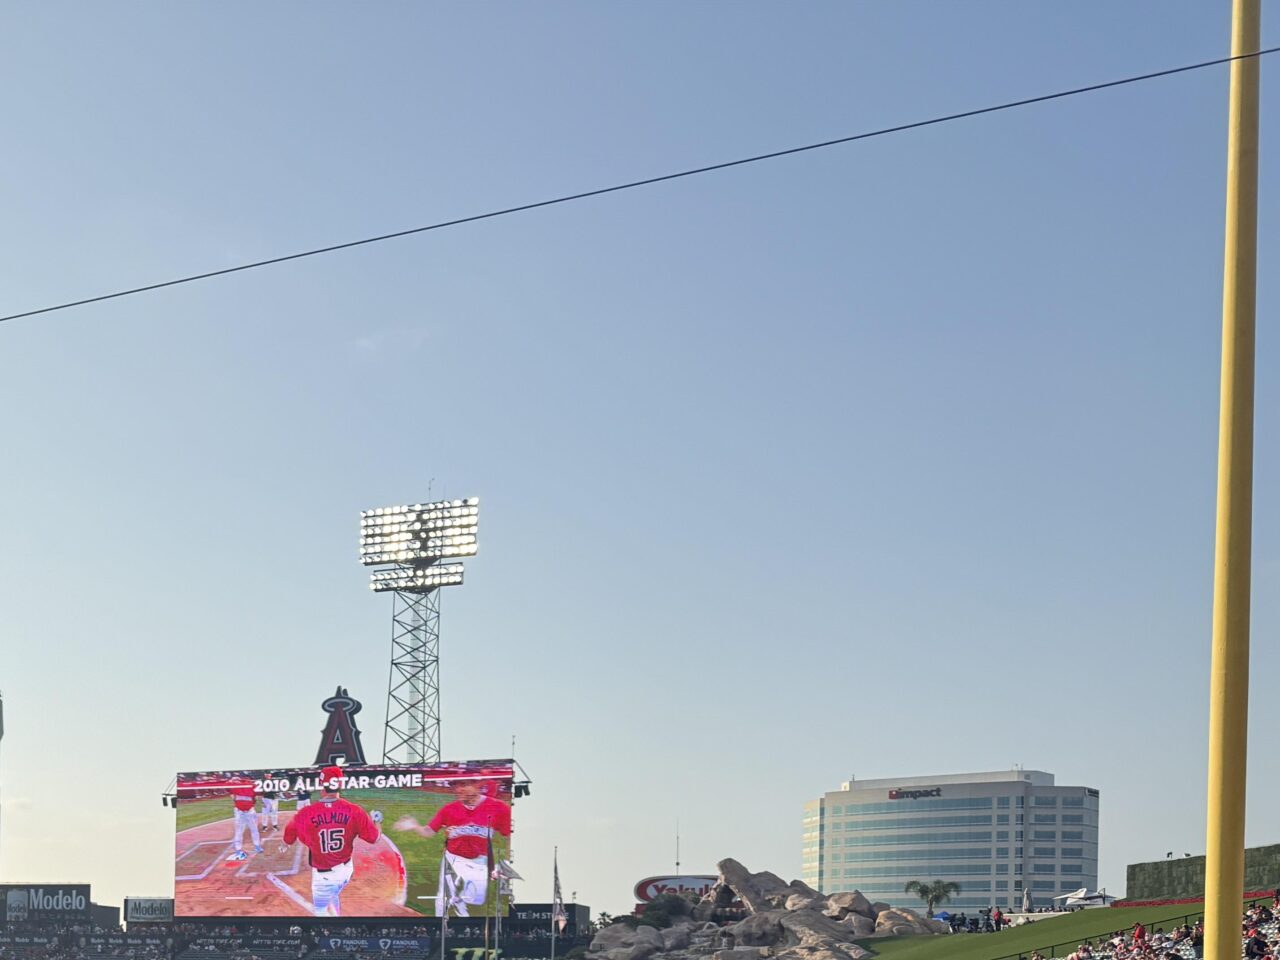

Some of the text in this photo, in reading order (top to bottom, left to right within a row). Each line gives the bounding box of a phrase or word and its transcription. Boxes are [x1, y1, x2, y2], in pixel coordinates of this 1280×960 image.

[253, 773, 423, 792] 2010 ALL-STAR GAME
[898, 787, 942, 800] impact
[311, 811, 351, 827] SALMON
[319, 828, 345, 854] 15
[29, 888, 86, 910] Modelo
[132, 901, 168, 915] Modelo
